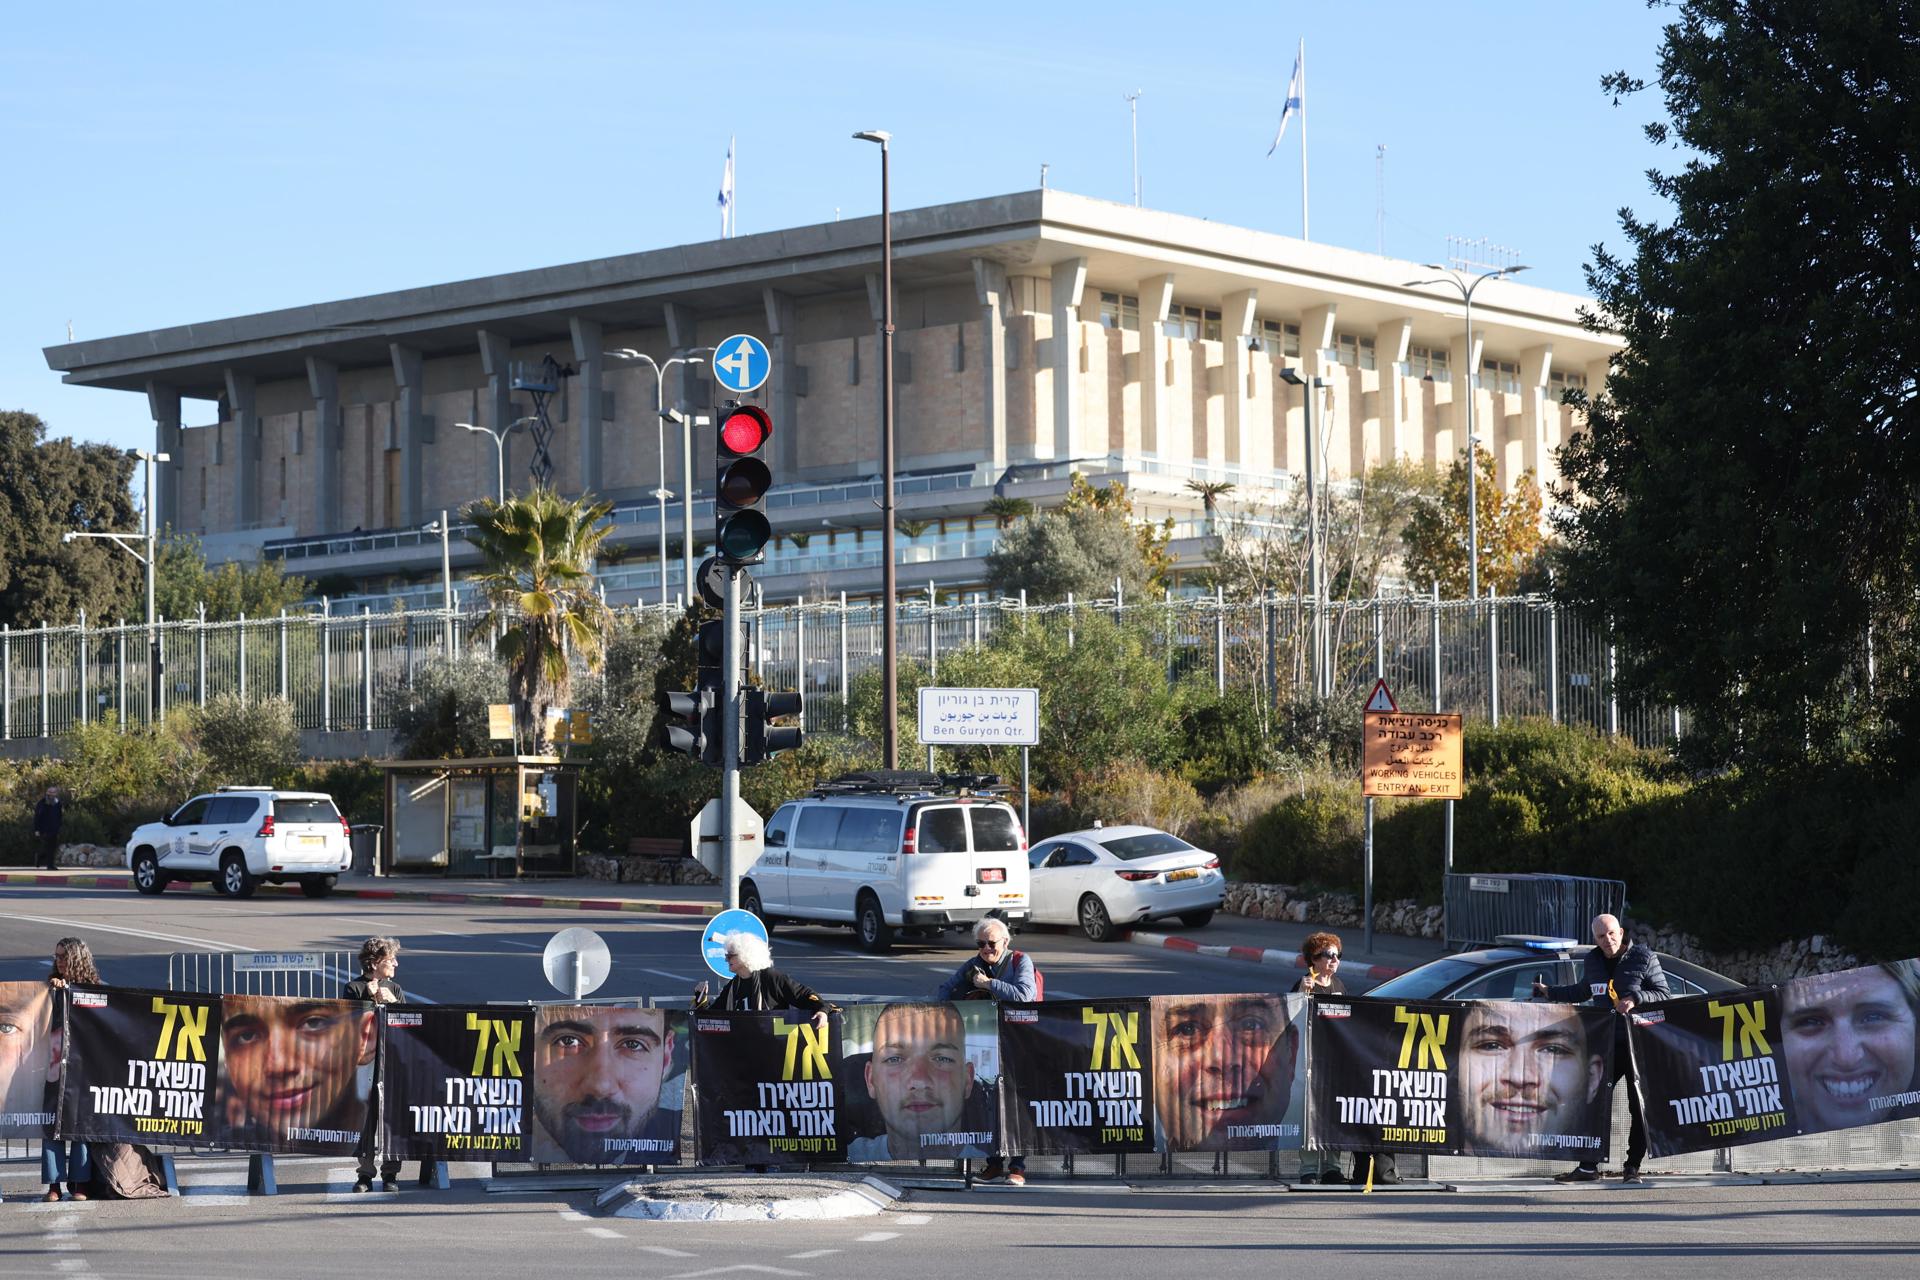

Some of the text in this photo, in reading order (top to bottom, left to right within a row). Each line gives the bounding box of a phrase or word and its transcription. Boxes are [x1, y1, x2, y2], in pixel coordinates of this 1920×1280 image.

[938, 695, 1019, 708] קרית בן גוריון
[934, 726, 1025, 737] Ben Guryon Qtr.
[1378, 716, 1448, 728] כניסה ויציאת
[1378, 730, 1442, 740] רכב עבודה
[1378, 782, 1407, 792] ENTRY
[1430, 784, 1451, 793] EXIT
[1412, 771, 1457, 780] VEHICLES
[254, 954, 304, 964] קשת במות
[152, 997, 209, 1061] אל
[1082, 1006, 1142, 1070] אל
[1394, 1006, 1449, 1070] אל
[1708, 1000, 1773, 1062] אל
[466, 1012, 522, 1077] אל
[773, 1017, 833, 1081] אל
[128, 1059, 206, 1090] תשאירו
[1064, 1070, 1142, 1099] תשאירו
[1372, 1069, 1448, 1099] תשאירו
[1700, 1056, 1778, 1093] תשאירו
[90, 1086, 204, 1119] אותי מאחור
[446, 1077, 522, 1106] תשאירו
[757, 1081, 834, 1110] תשאירו
[1669, 1083, 1784, 1126] אותי מאחור
[135, 1117, 202, 1136] עידן אלכסנדר
[410, 1105, 522, 1134] אותי מאחור
[724, 1109, 836, 1137] אותי מאחור
[1030, 1099, 1143, 1128] אותי מאחור
[1336, 1096, 1446, 1128] אותי מאחור
[1706, 1112, 1786, 1137] דורון שטיינברכר
[446, 1134, 520, 1150] גיא גלבוע דלאל
[768, 1138, 837, 1154] בר קופרשטיין
[1102, 1128, 1144, 1144] צחי עידן
[1381, 1128, 1446, 1144] סשה טרופנוב
